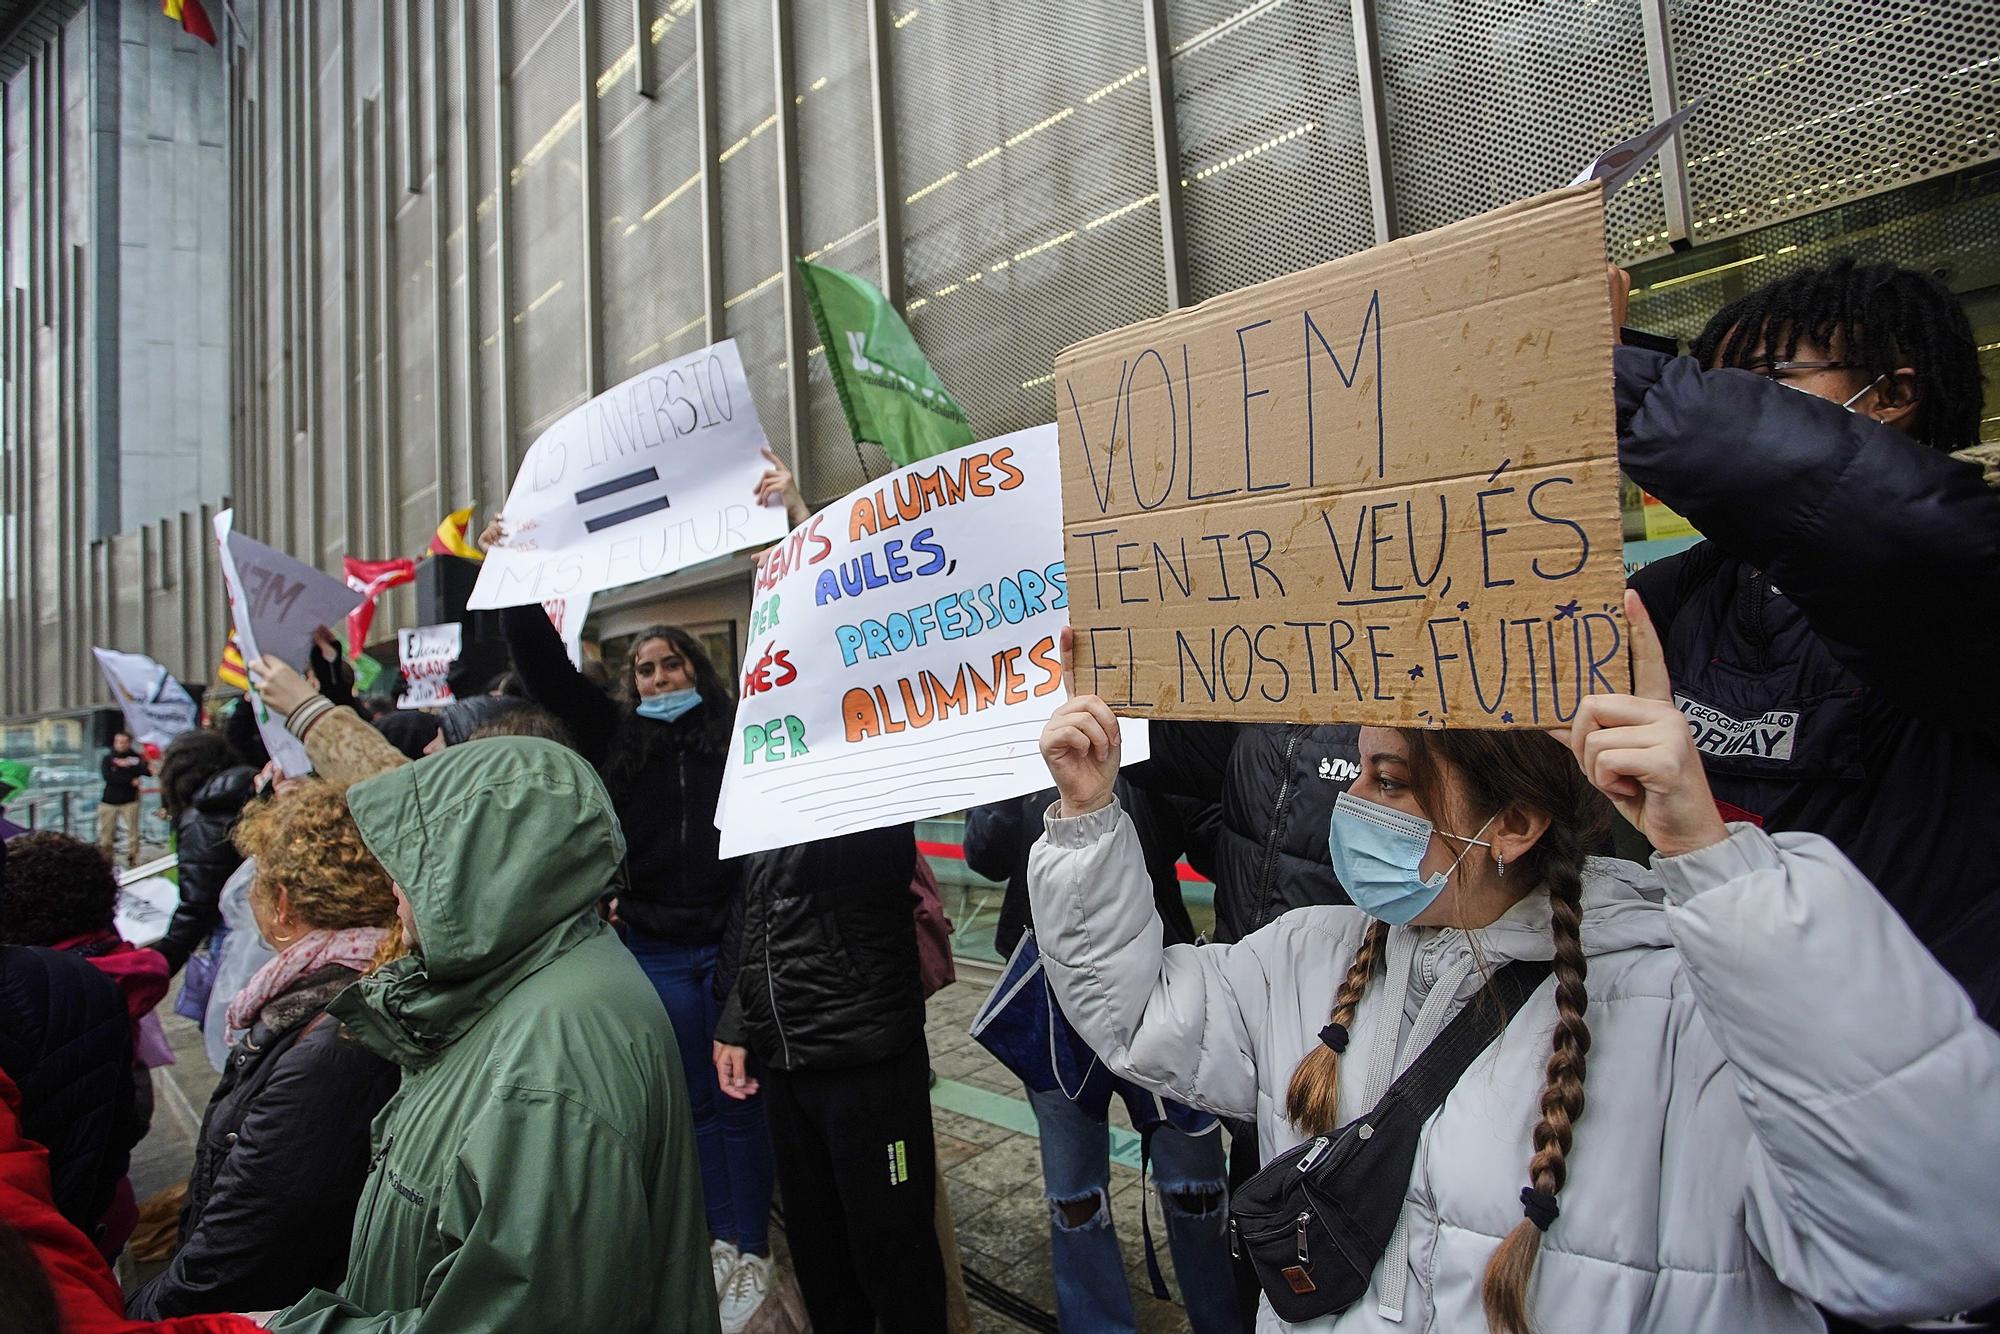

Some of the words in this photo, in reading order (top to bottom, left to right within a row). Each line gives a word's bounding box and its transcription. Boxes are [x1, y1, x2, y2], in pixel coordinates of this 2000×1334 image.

[1066, 289, 1384, 514] VOLEM
[605, 504, 750, 583] FUTUR
[749, 593, 781, 647] PER
[815, 527, 956, 607] AULES,
[755, 514, 832, 598] MENYS
[848, 446, 1025, 542] ALUMNES
[1073, 528, 1286, 609] TENIR
[1476, 458, 1590, 589] ÉS
[742, 640, 797, 700] MÉS
[835, 561, 1068, 669] PROFESSORS
[1090, 626, 1154, 707] EL
[1175, 618, 1396, 704] NOSTRE
[1428, 612, 1621, 724] FUTUR
[742, 713, 809, 765] PER
[841, 636, 1062, 744] ALUMNES
